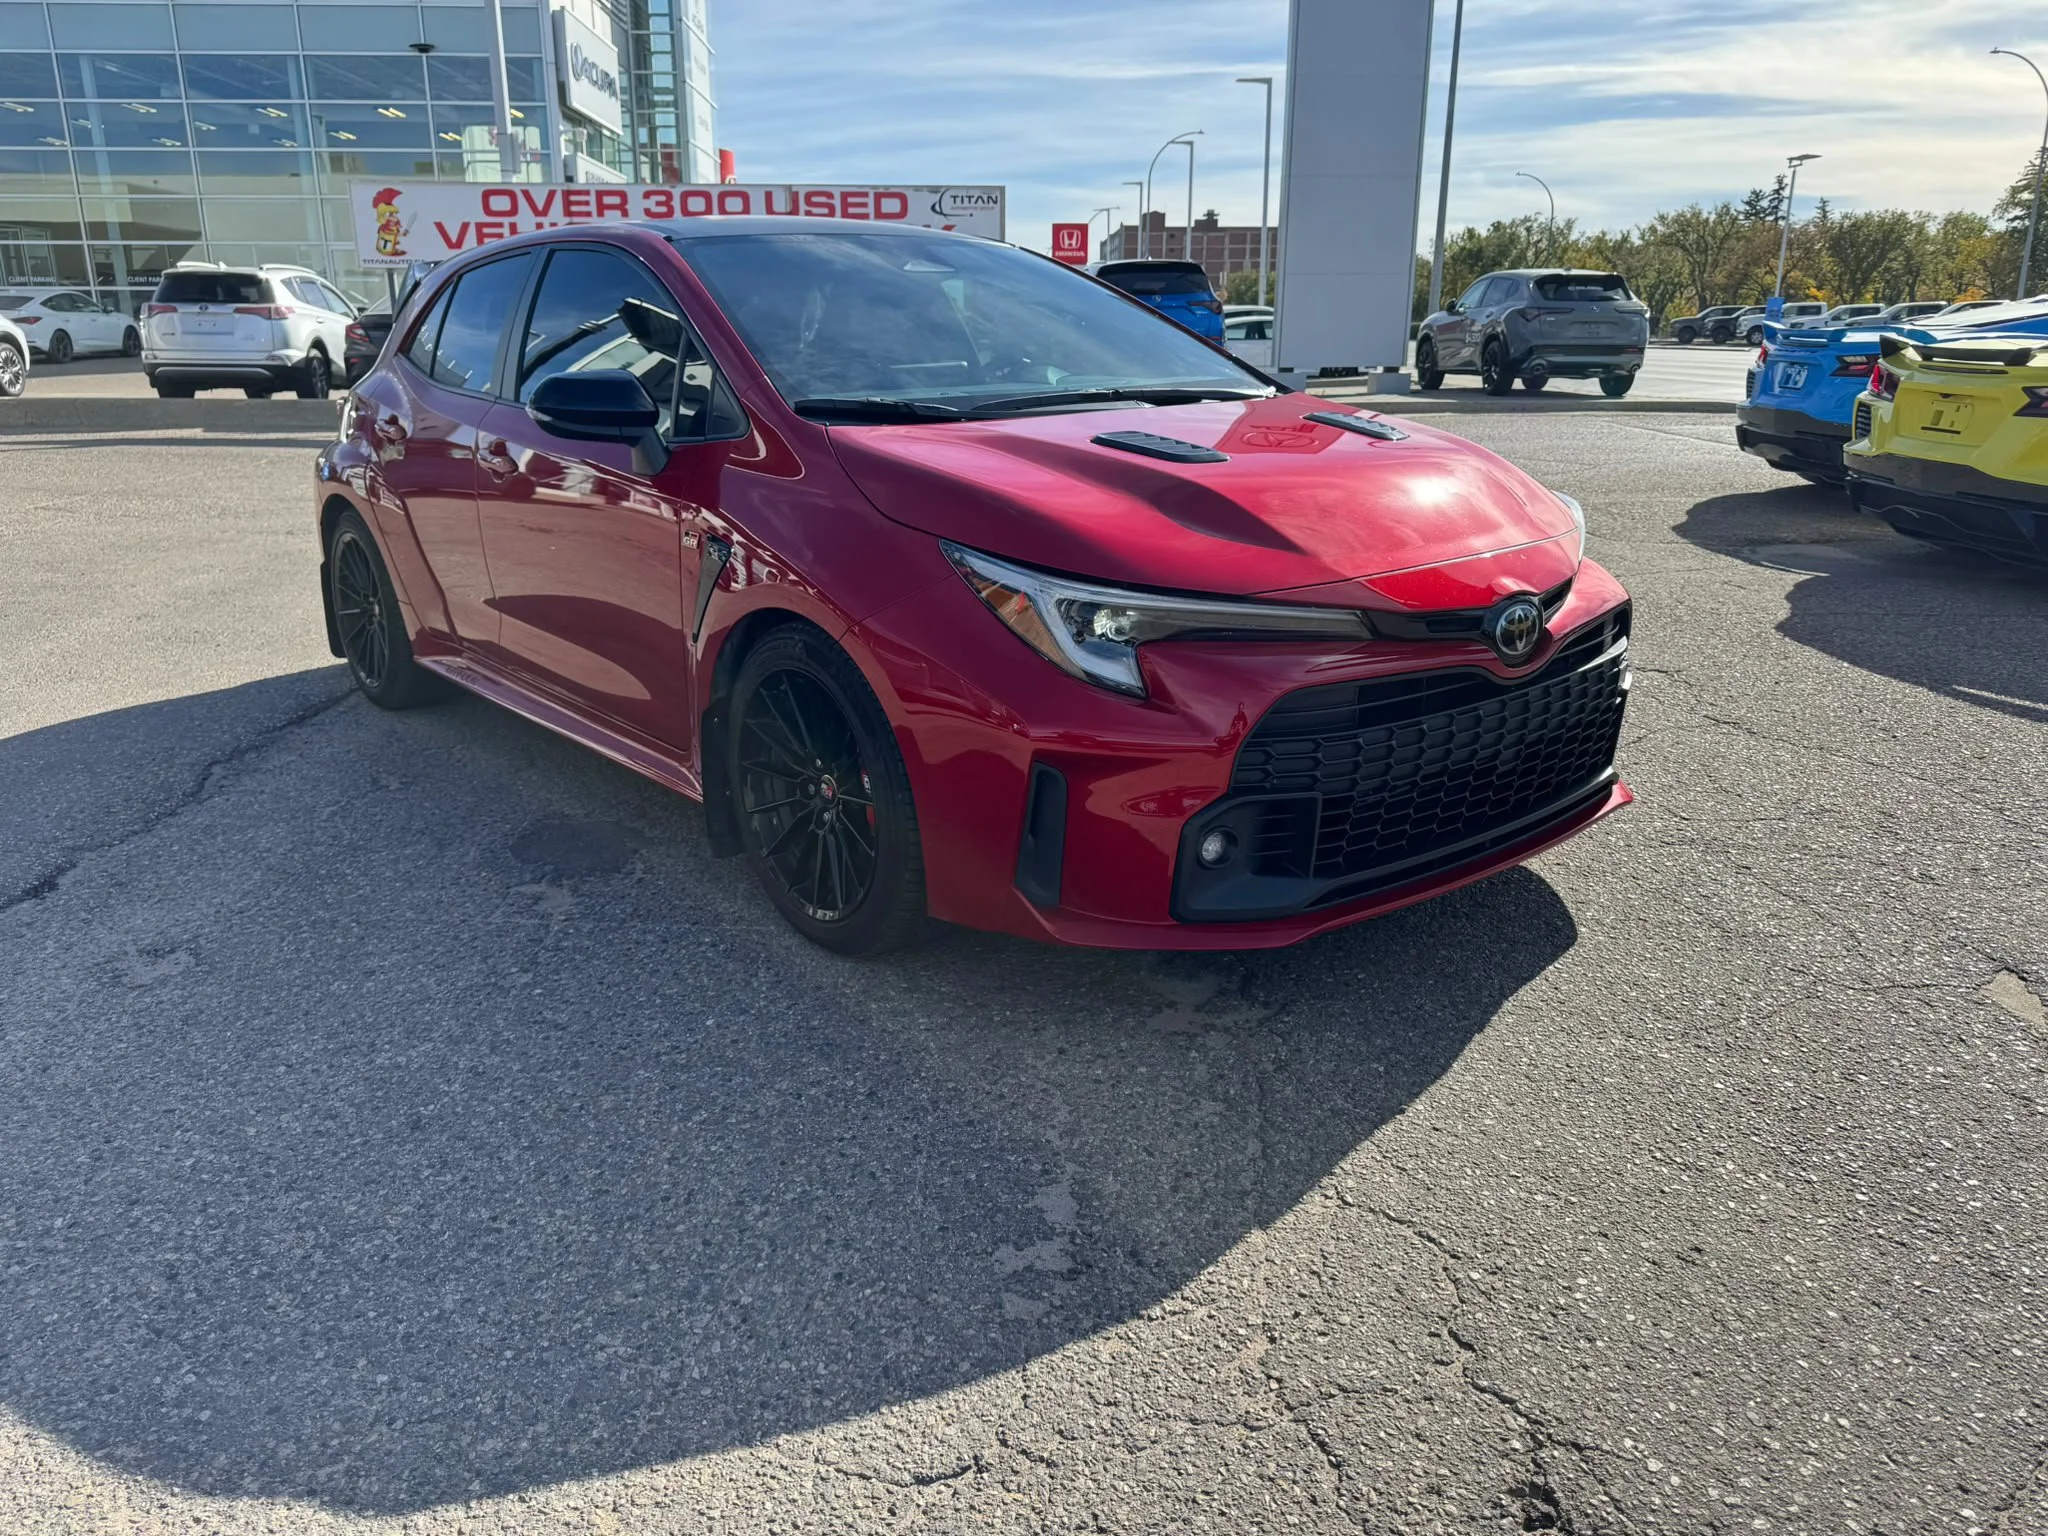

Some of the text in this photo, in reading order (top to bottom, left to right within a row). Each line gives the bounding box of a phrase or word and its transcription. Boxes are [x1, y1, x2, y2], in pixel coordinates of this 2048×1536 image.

[582, 57, 618, 101] ACURA
[481, 188, 909, 221] OVER 300 USED
[950, 195, 998, 205] TITAN
